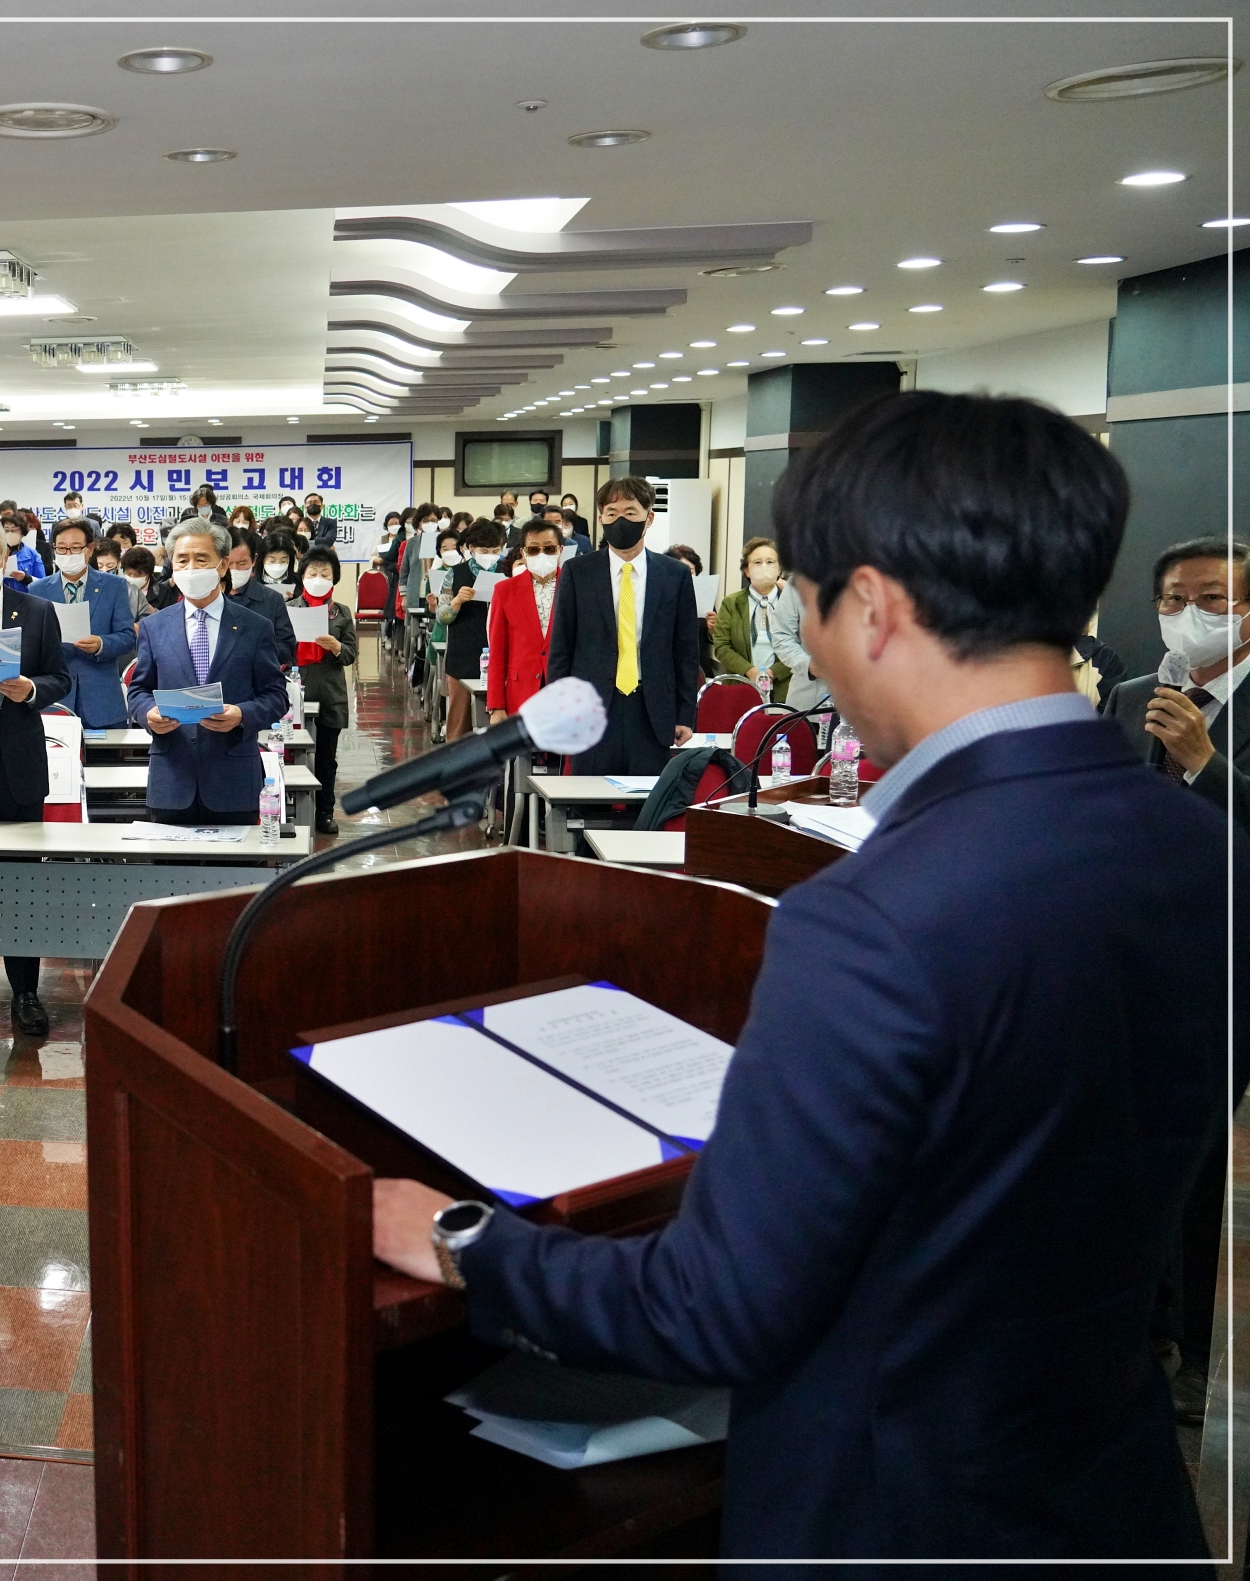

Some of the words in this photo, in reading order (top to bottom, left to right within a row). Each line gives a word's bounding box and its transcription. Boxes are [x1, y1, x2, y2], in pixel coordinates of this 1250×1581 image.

[128, 454, 207, 464] 부산도심철도시설
[211, 452, 240, 463] 이전을
[244, 452, 264, 463] 위한
[53, 470, 119, 492] 2022
